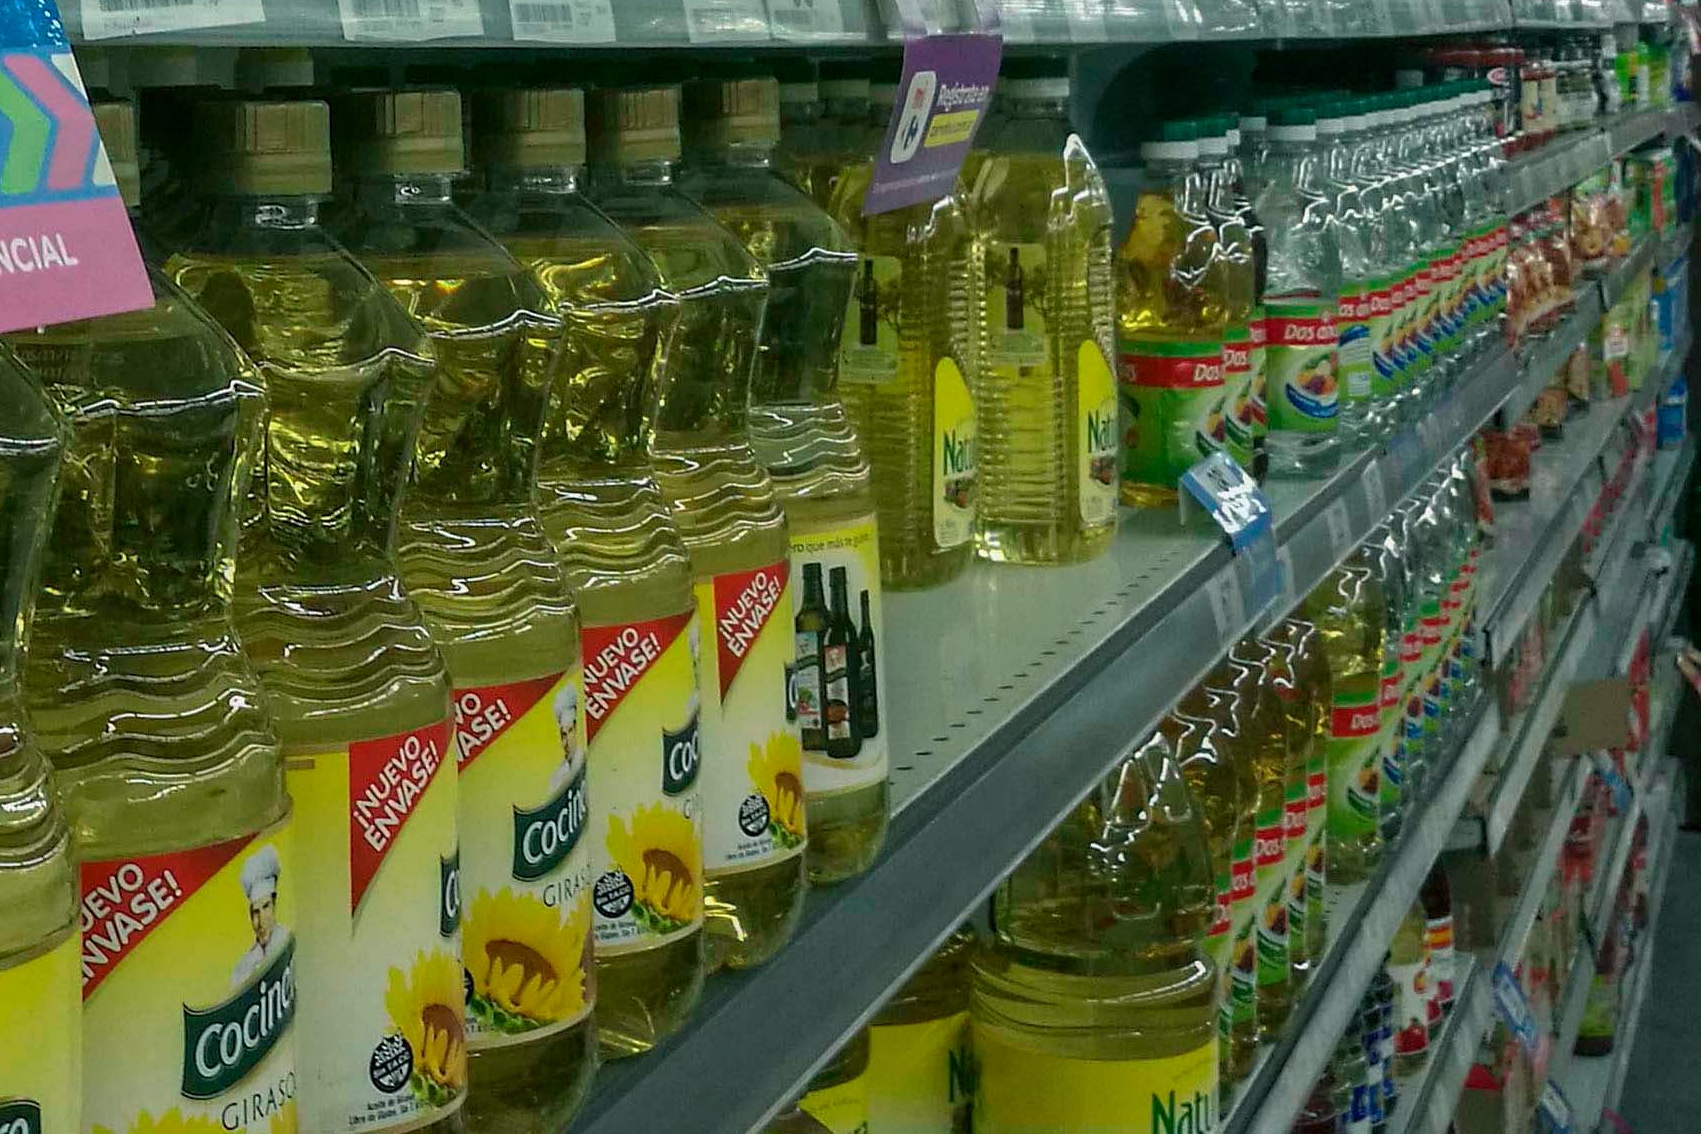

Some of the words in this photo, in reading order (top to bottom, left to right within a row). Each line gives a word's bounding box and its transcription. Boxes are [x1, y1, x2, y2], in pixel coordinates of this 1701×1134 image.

[719, 571, 767, 641] ¡NUEVO
[726, 575, 782, 659] ENVASE!
[585, 632, 662, 720] ENVASE!
[353, 735, 421, 829] ¡NUEVO
[363, 739, 440, 852] ENVASE!
